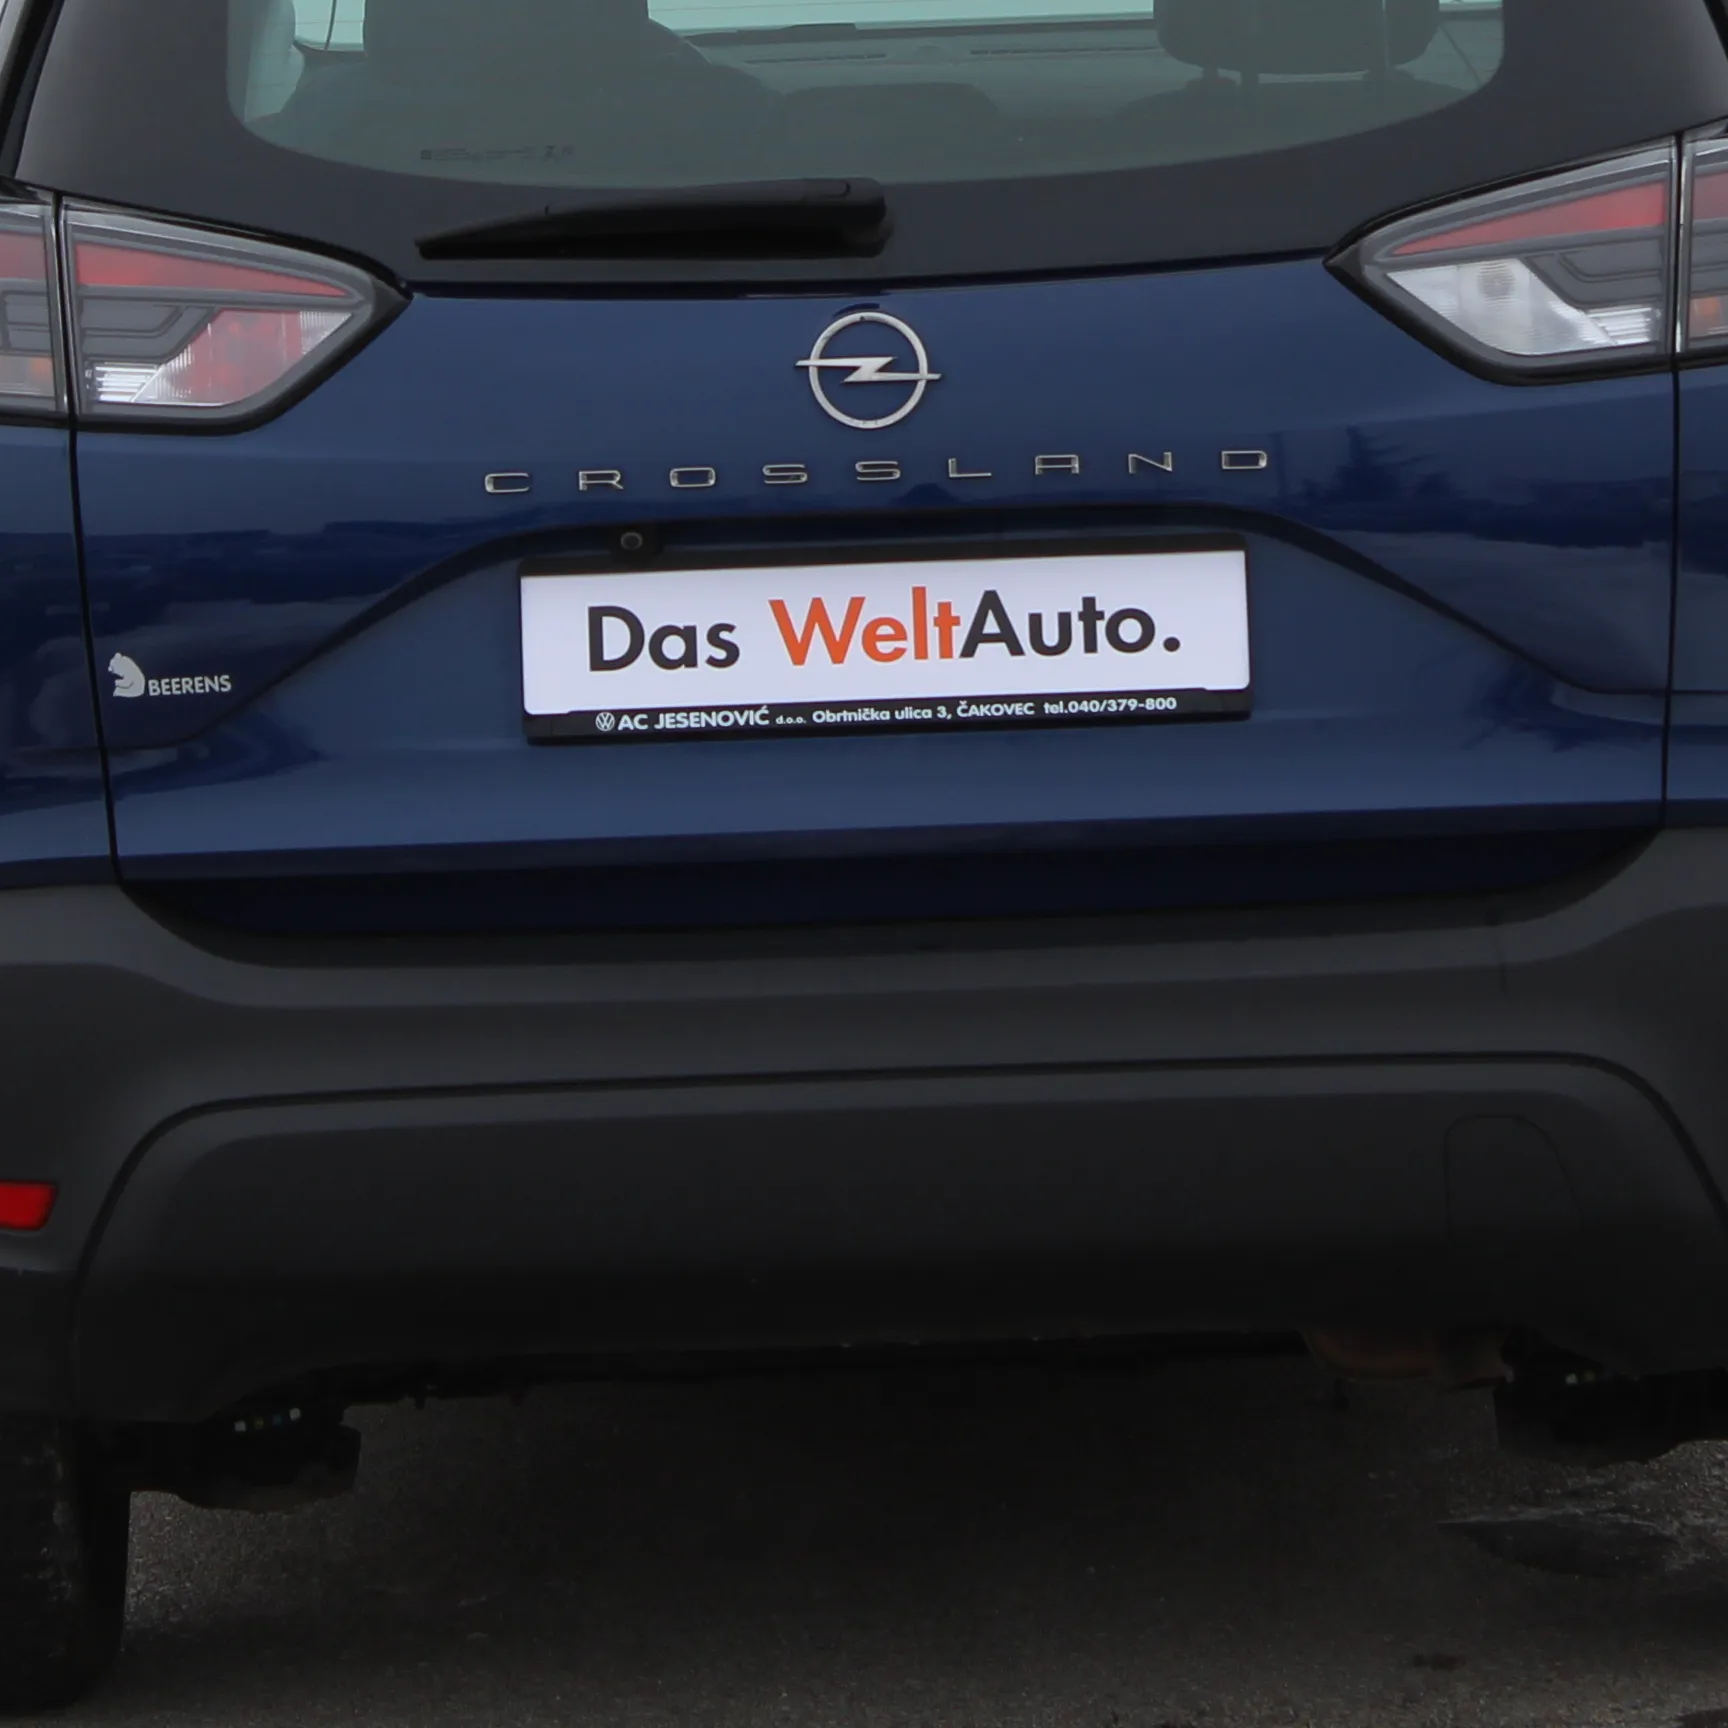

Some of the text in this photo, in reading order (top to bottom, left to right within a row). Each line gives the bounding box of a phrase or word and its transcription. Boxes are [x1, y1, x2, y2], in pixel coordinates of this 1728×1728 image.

[484, 449, 1269, 494] CROSSLAND
[587, 586, 1181, 672] Das WeltAuto.
[148, 675, 232, 696] BEERENS
[617, 713, 649, 731] AC
[653, 705, 770, 730] JESENOVIĆ
[775, 715, 807, 725] d.o.o.
[812, 708, 891, 724] Obrtnička
[894, 706, 932, 720] ulica
[936, 705, 952, 720] 3,
[956, 700, 1036, 718] ČAKOVEC
